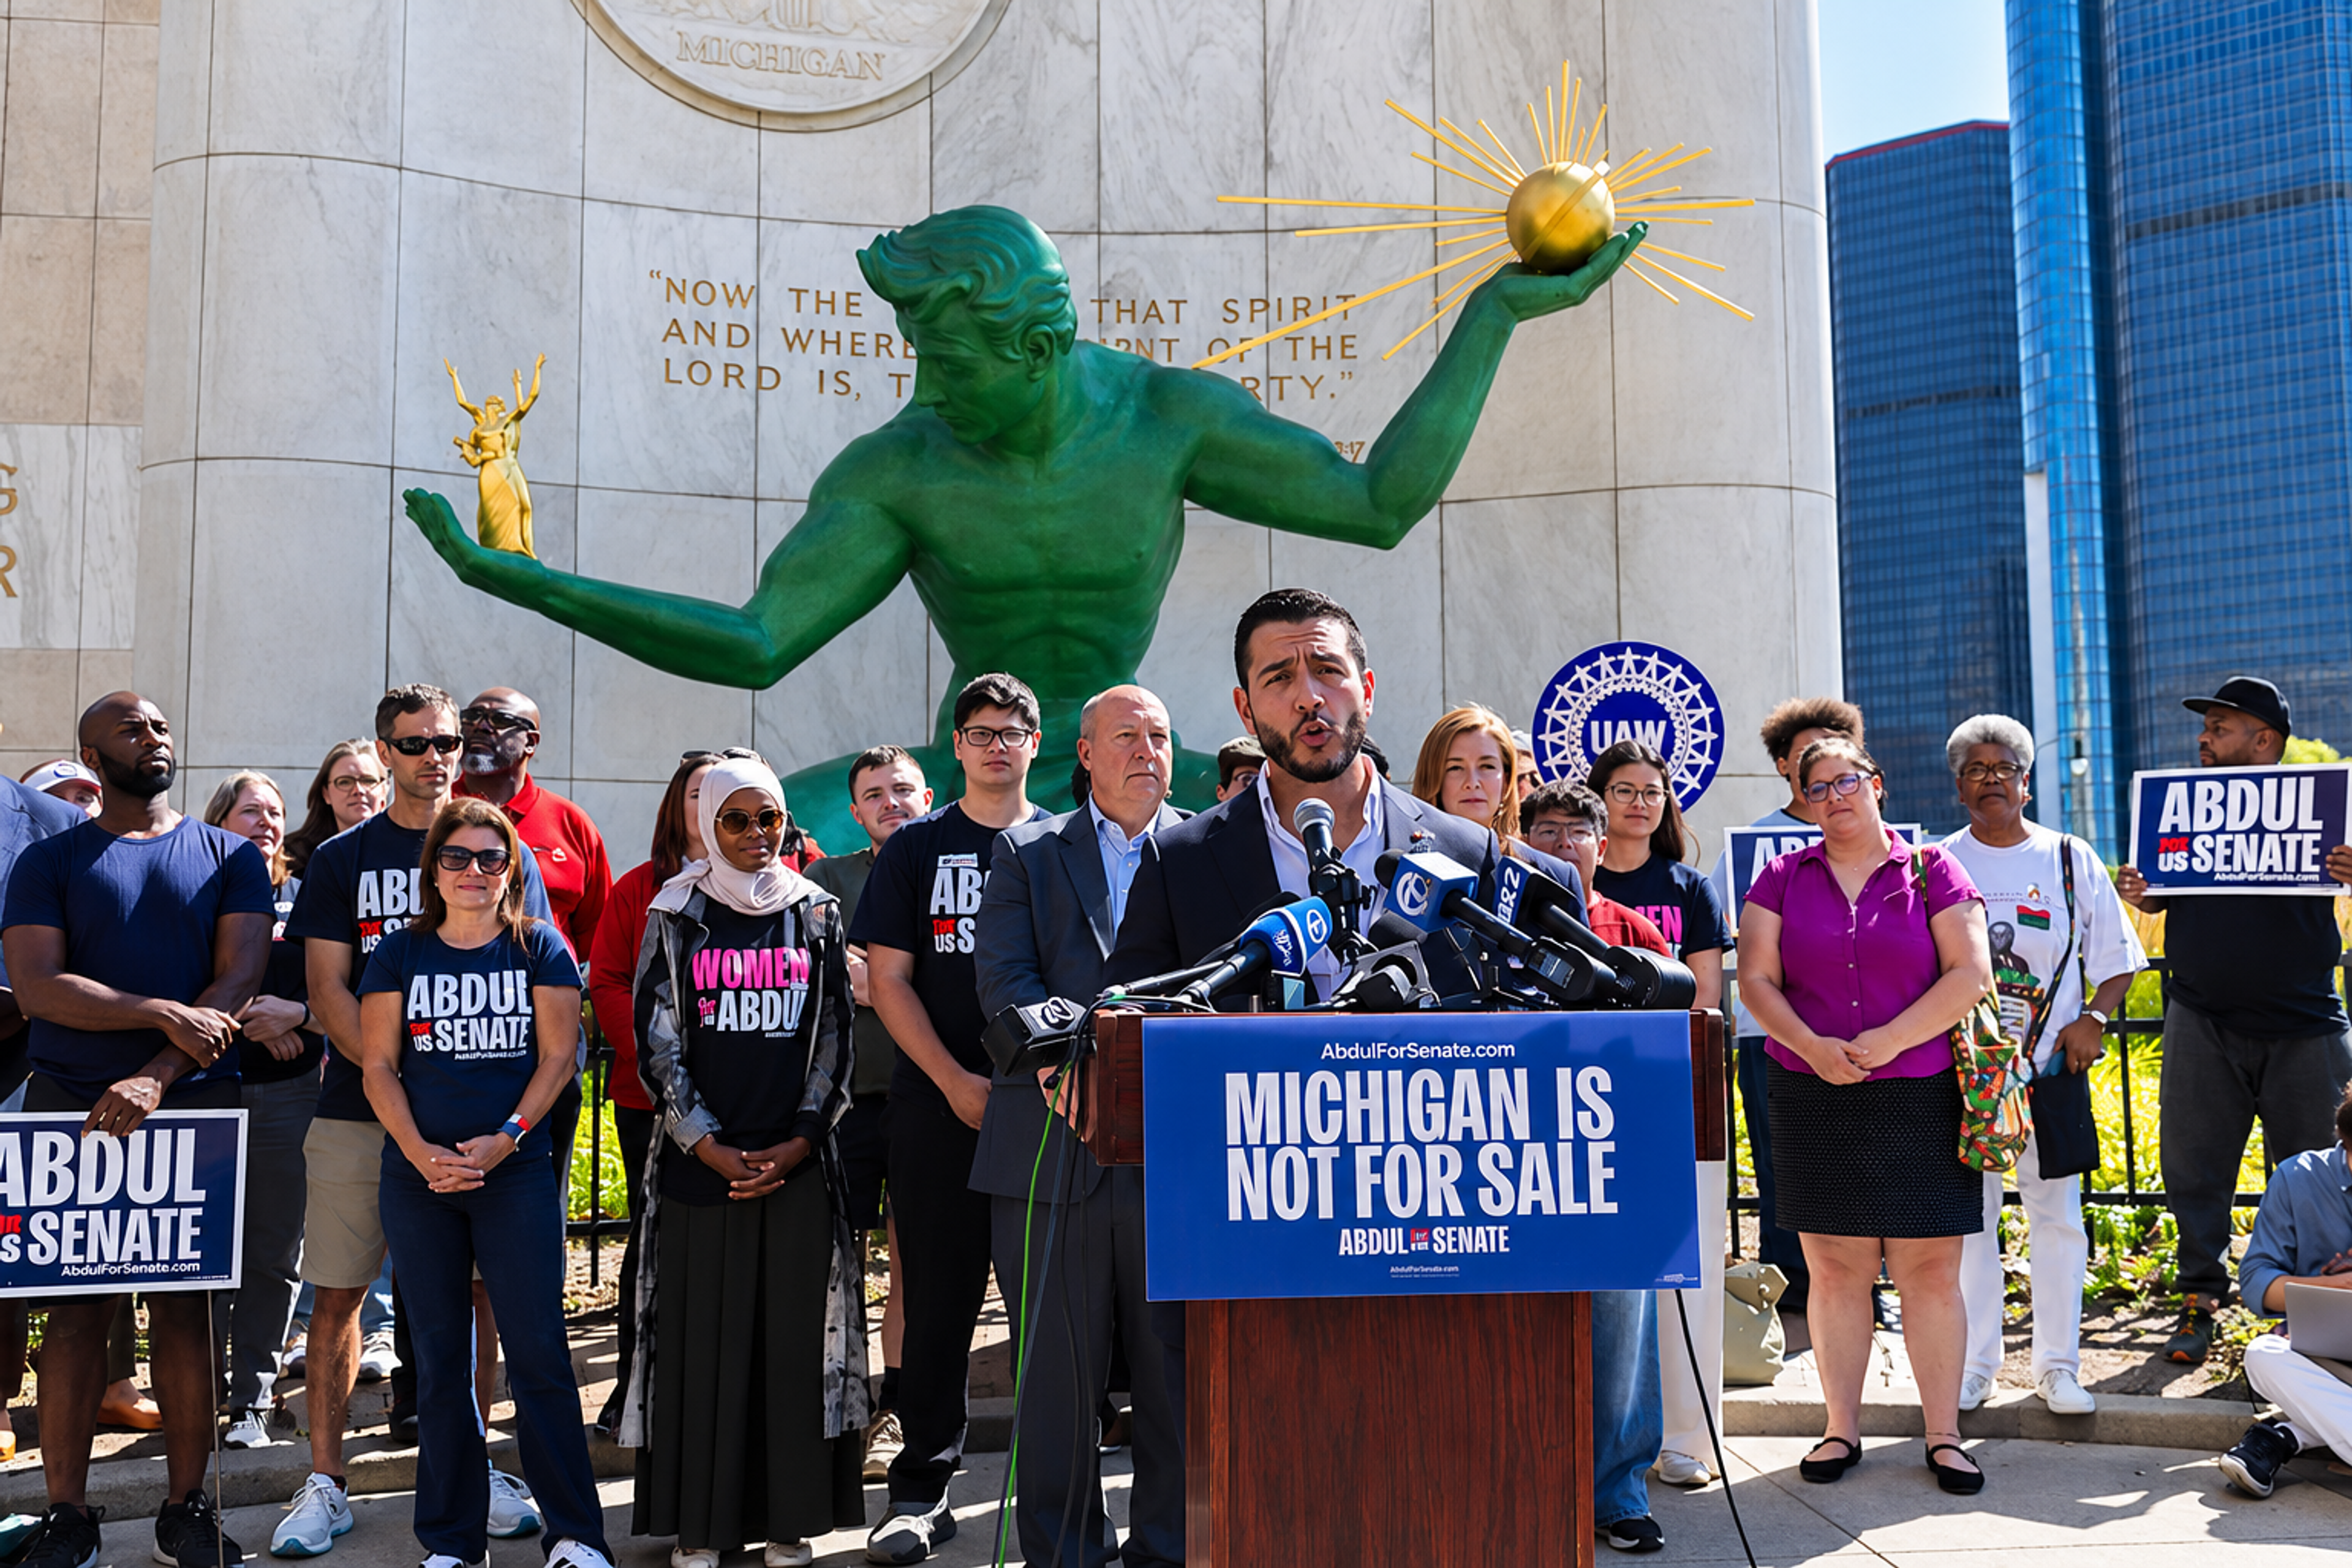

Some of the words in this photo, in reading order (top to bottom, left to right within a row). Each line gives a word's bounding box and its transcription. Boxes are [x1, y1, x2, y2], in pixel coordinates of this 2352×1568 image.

[676, 31, 886, 80] MICHIGAN
[788, 287, 862, 317] THE
[1090, 298, 1188, 324] THAT
[1222, 294, 1356, 323] SPIRIT
[662, 318, 750, 349] AND
[1284, 334, 1358, 361] THE
[665, 358, 782, 390] LORD
[818, 369, 861, 402] IS,
[1591, 720, 1667, 760] UAW
[2157, 776, 2323, 833] ABDUL
[2158, 851, 2189, 872] US
[2192, 832, 2322, 873] SENATE
[934, 933, 956, 953] US
[692, 946, 810, 990] WOMEN
[407, 970, 532, 1020] ABDUL
[413, 1035, 434, 1052] US
[434, 1016, 531, 1052] SENATE
[1321, 1042, 1515, 1059] AbdulForSenate.com
[1225, 1068, 1531, 1145] MICHIGAN
[1556, 1066, 1615, 1140] IS
[0, 1128, 206, 1207] ABDUL
[1227, 1147, 1340, 1221] NOT
[1354, 1144, 1464, 1218] FOR
[1477, 1140, 1619, 1216] SALE
[28, 1208, 203, 1265] SENATE
[1338, 1227, 1409, 1256] ABDUL
[1432, 1226, 1510, 1254] SENATE
